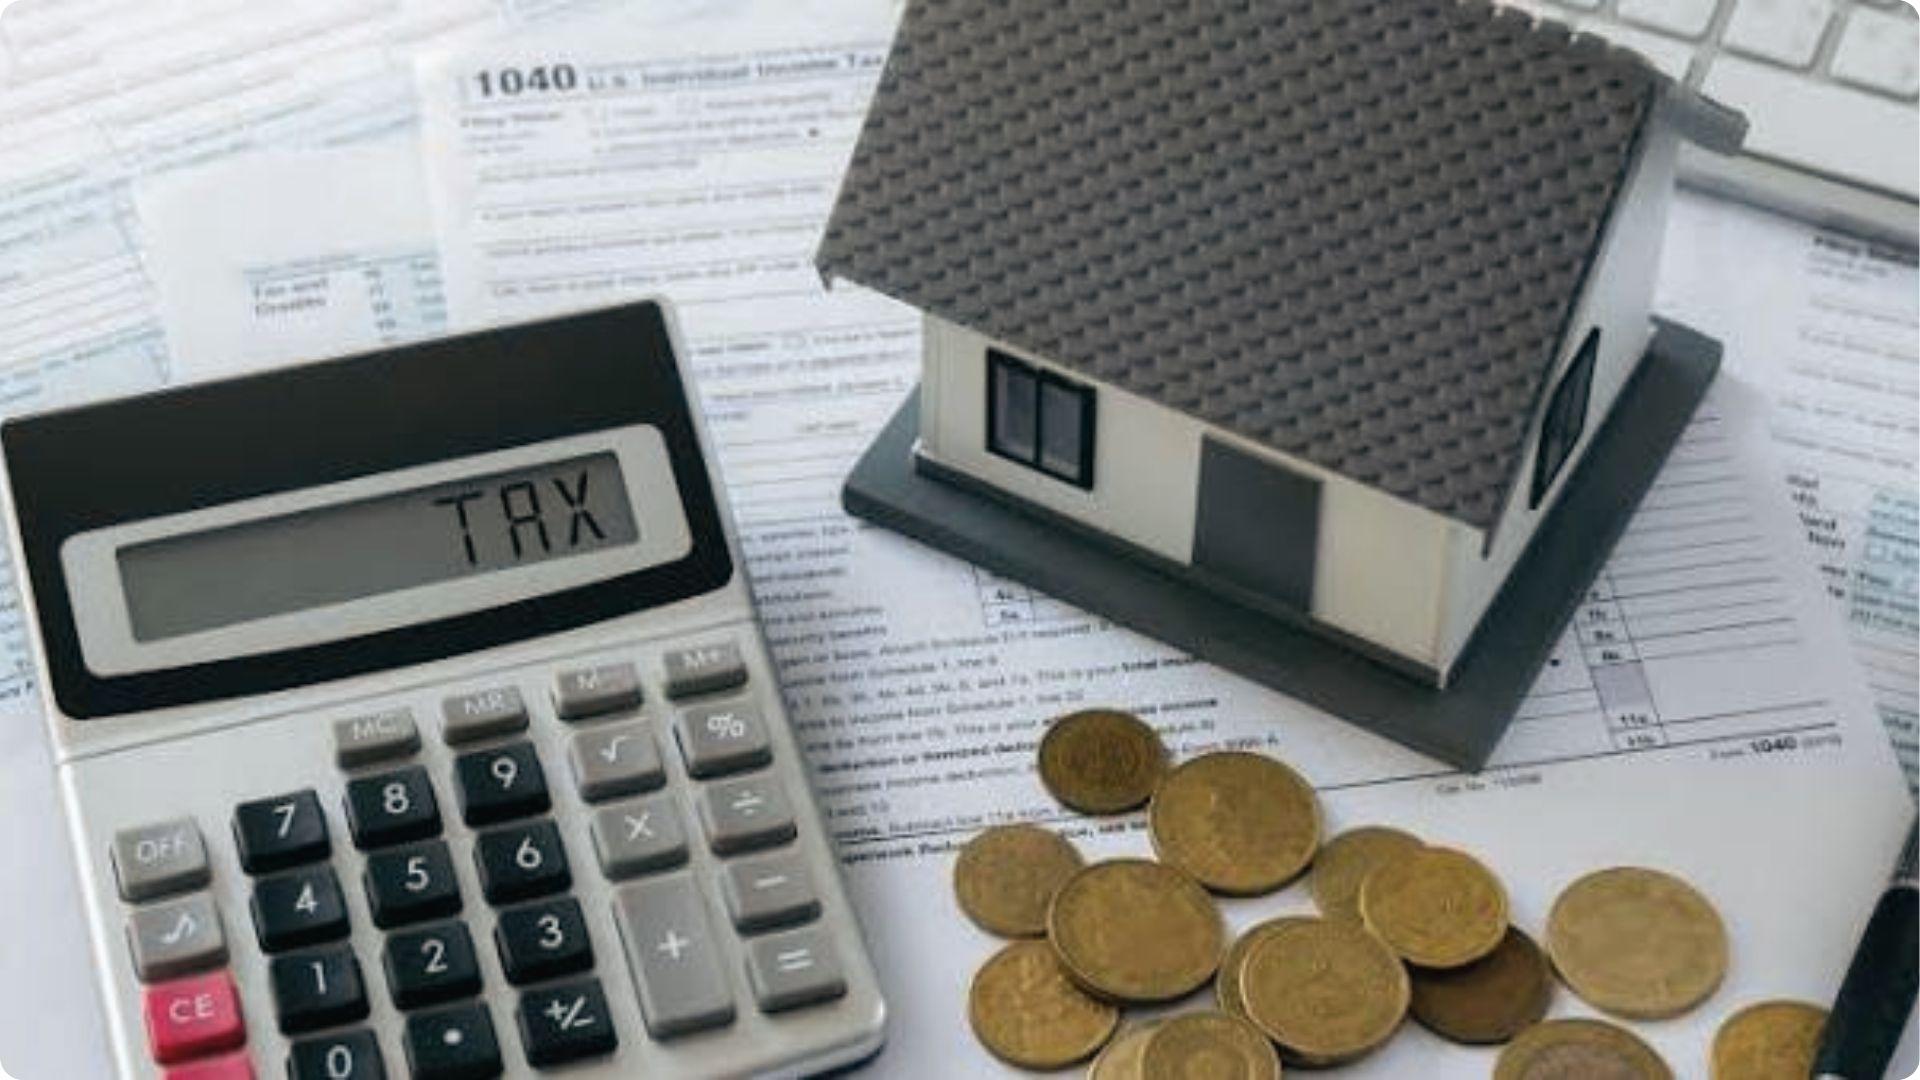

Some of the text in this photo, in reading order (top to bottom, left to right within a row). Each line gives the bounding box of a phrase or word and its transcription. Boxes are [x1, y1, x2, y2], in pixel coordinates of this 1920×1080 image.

[474, 63, 577, 97] 1040
[433, 470, 608, 567] TAX
[464, 692, 505, 715] MR
[352, 715, 398, 741] MC
[706, 711, 746, 740] %
[1750, 735, 1798, 755] 1040
[490, 756, 519, 790] 9
[384, 782, 410, 815] 8
[273, 803, 296, 839] 7
[136, 835, 187, 864] OFF
[515, 836, 543, 869] 6
[403, 856, 430, 892] 5
[293, 880, 319, 916] 4
[536, 914, 563, 949] 3
[420, 939, 449, 973] 2
[310, 961, 328, 995] 1
[168, 991, 217, 1024] CE
[327, 1043, 352, 1079] 0
